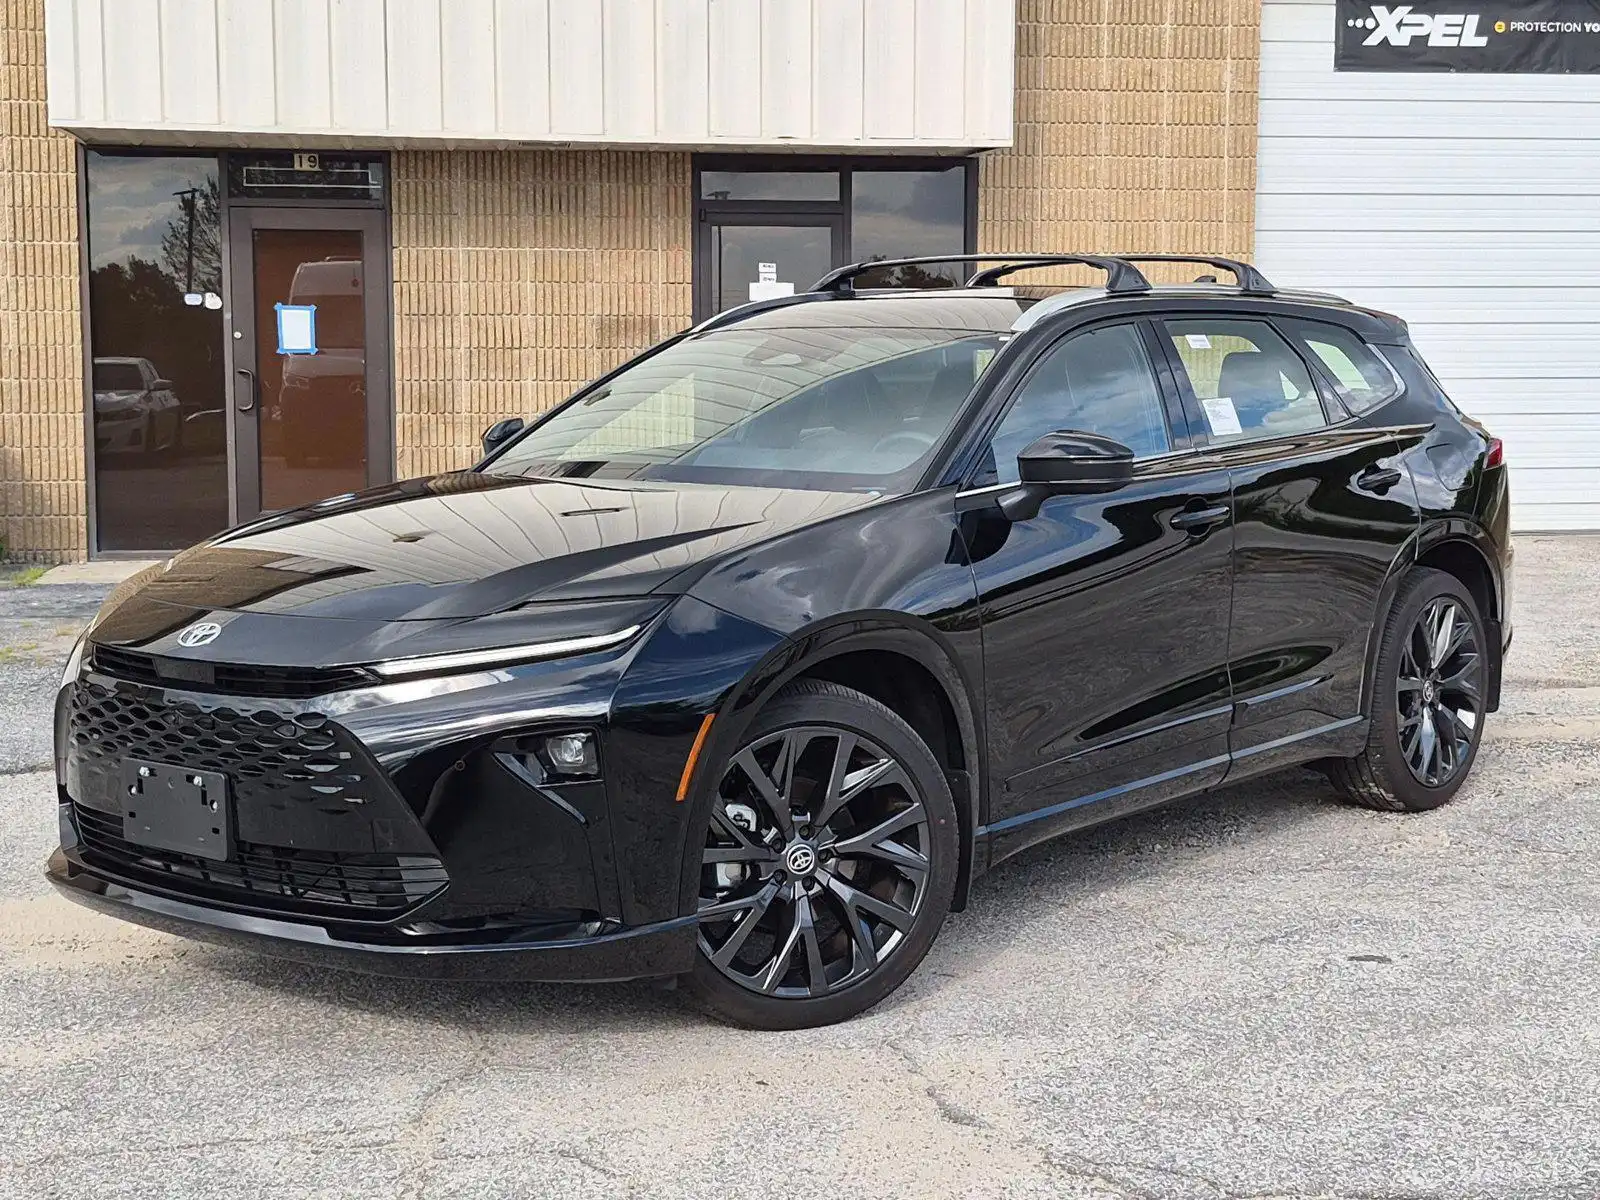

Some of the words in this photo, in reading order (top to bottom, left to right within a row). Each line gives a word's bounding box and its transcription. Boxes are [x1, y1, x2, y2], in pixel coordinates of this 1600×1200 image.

[1362, 5, 1488, 47] XPEL
[1510, 21, 1581, 33] PROTECTION
[299, 155, 318, 168] 19
